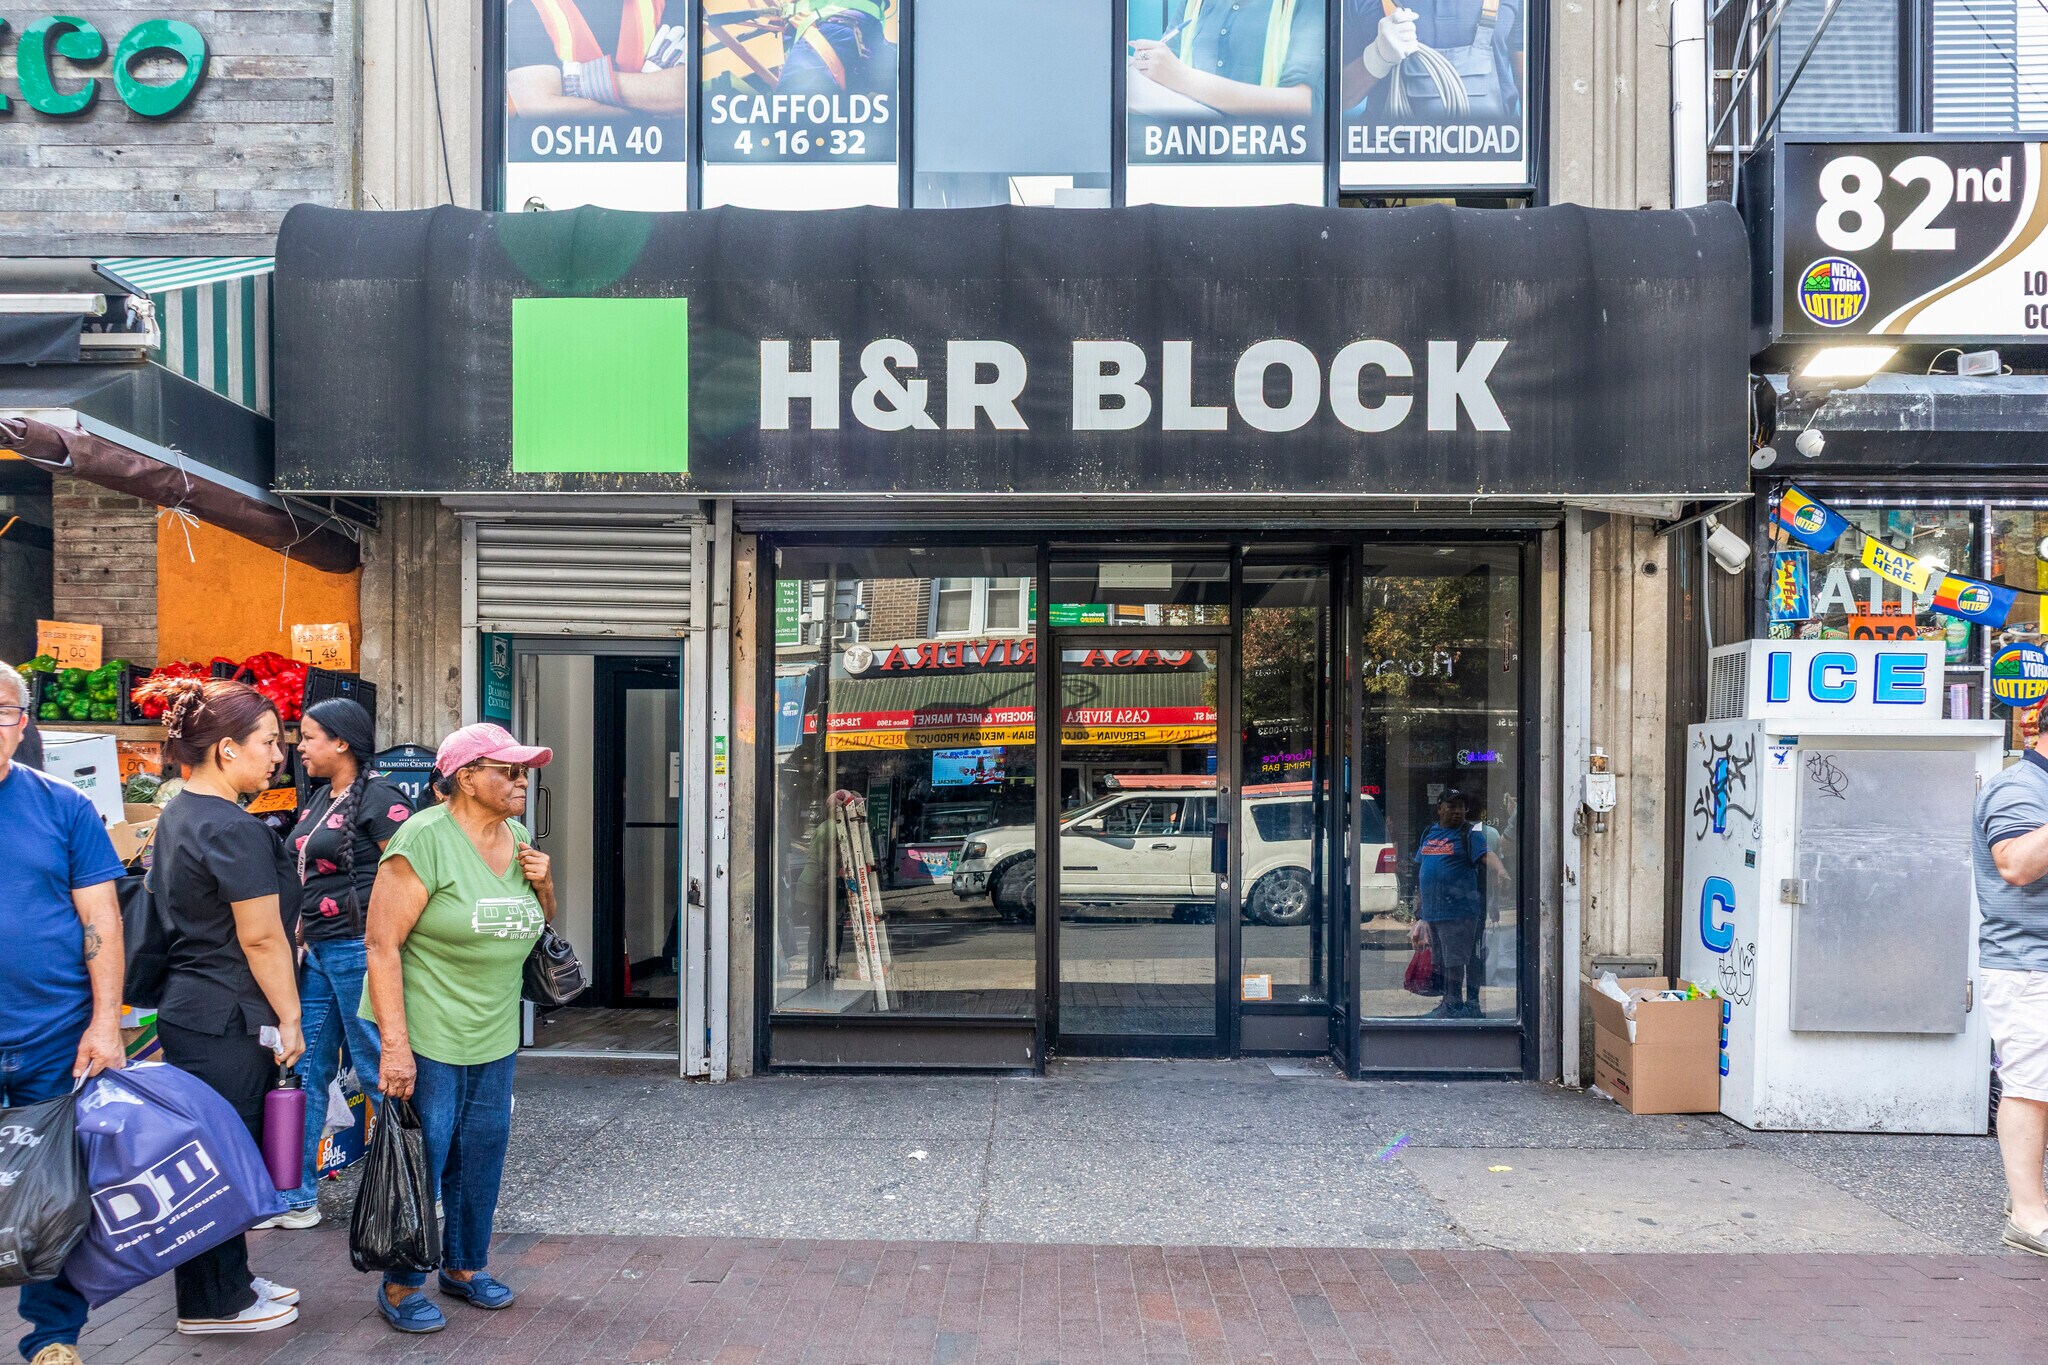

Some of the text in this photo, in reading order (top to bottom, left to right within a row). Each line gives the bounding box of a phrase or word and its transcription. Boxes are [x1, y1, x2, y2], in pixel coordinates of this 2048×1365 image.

[710, 94, 889, 124] SCAFFOLDS
[531, 125, 663, 155] OSHA 40
[1145, 125, 1307, 155] BANDERAS
[1347, 124, 1521, 155] ELECTRICIDAD
[1815, 155, 2012, 251] 82nd
[1831, 263, 1857, 279] NEW
[1831, 277, 1861, 292] YORK
[1804, 293, 1863, 320] LOTTERY
[760, 338, 1511, 432] H&R BLOCK
[1871, 556, 1916, 585] HERE.
[1875, 546, 1915, 570] PLAY
[2022, 650, 2045, 663] NEW
[1767, 651, 1928, 704] ICE
[349, 1093, 365, 1108] GOLD
[115, 1184, 231, 1252] deals & discounts
[155, 1220, 217, 1257] www.Dii.com
